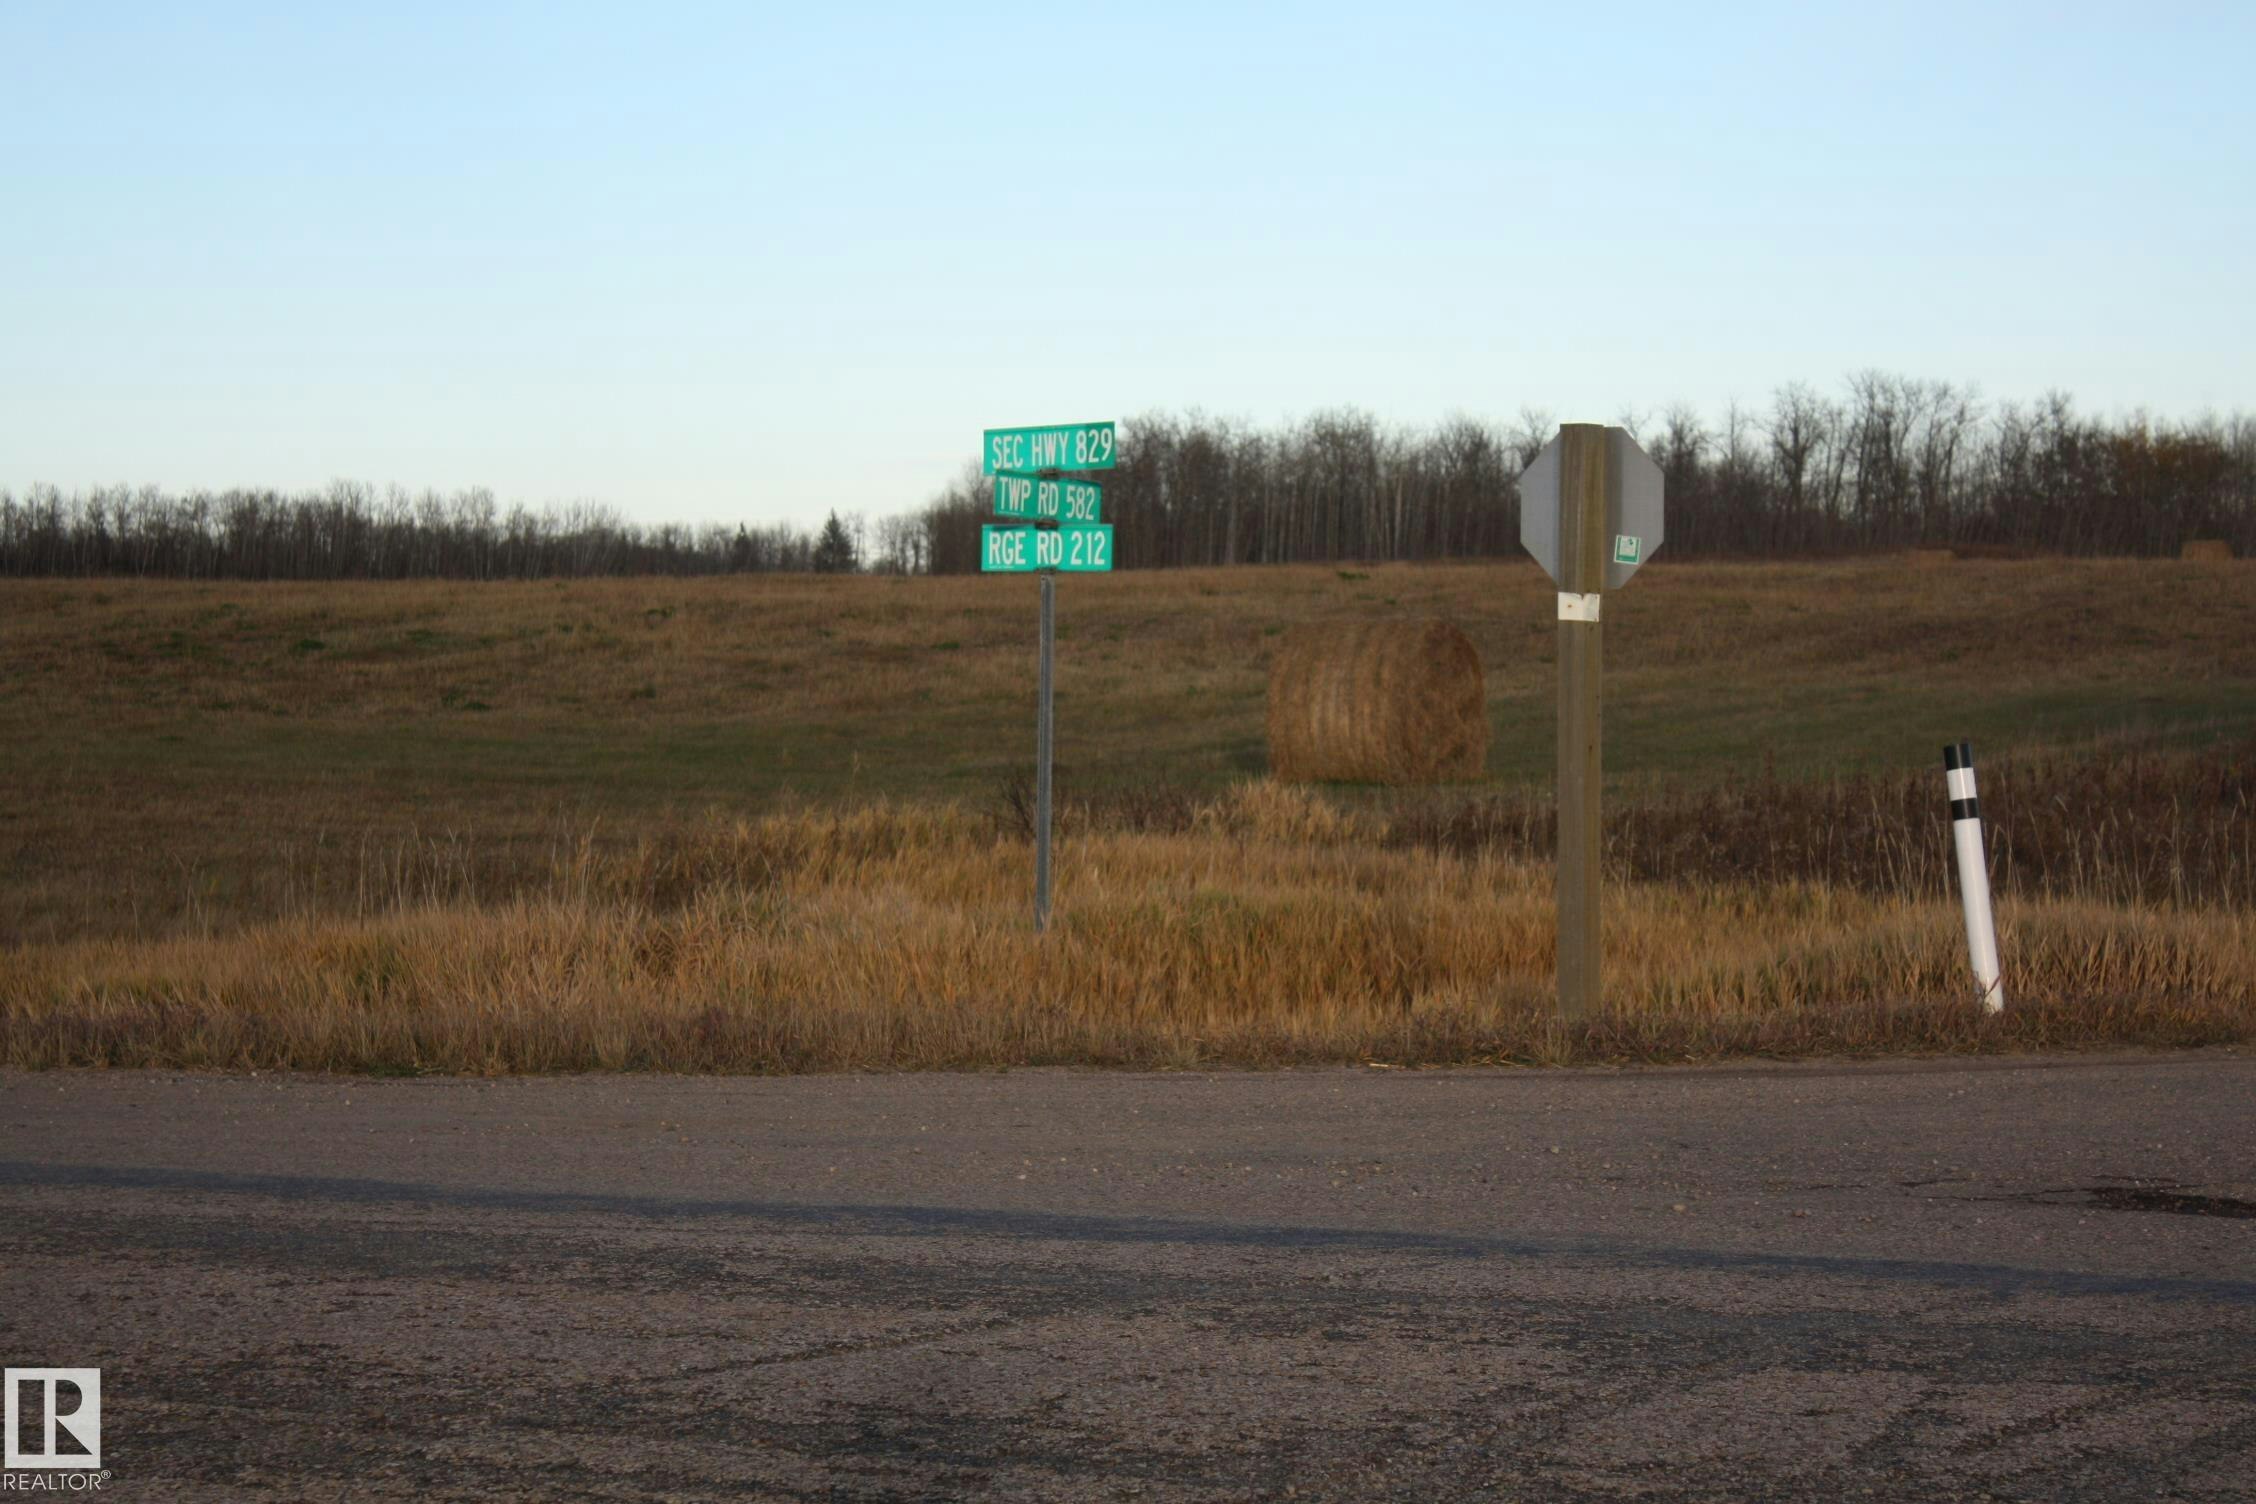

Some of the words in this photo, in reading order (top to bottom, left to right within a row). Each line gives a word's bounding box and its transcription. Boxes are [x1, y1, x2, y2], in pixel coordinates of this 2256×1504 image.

[992, 435, 1024, 469] SEC
[1031, 431, 1069, 467] HWY
[1075, 428, 1113, 464] 829
[999, 476, 1031, 512] TWP
[1037, 481, 1059, 516] RD
[1066, 485, 1095, 520] 582
[988, 531, 1026, 565] RGE
[1037, 531, 1063, 565] RD
[1070, 531, 1106, 565] 212
